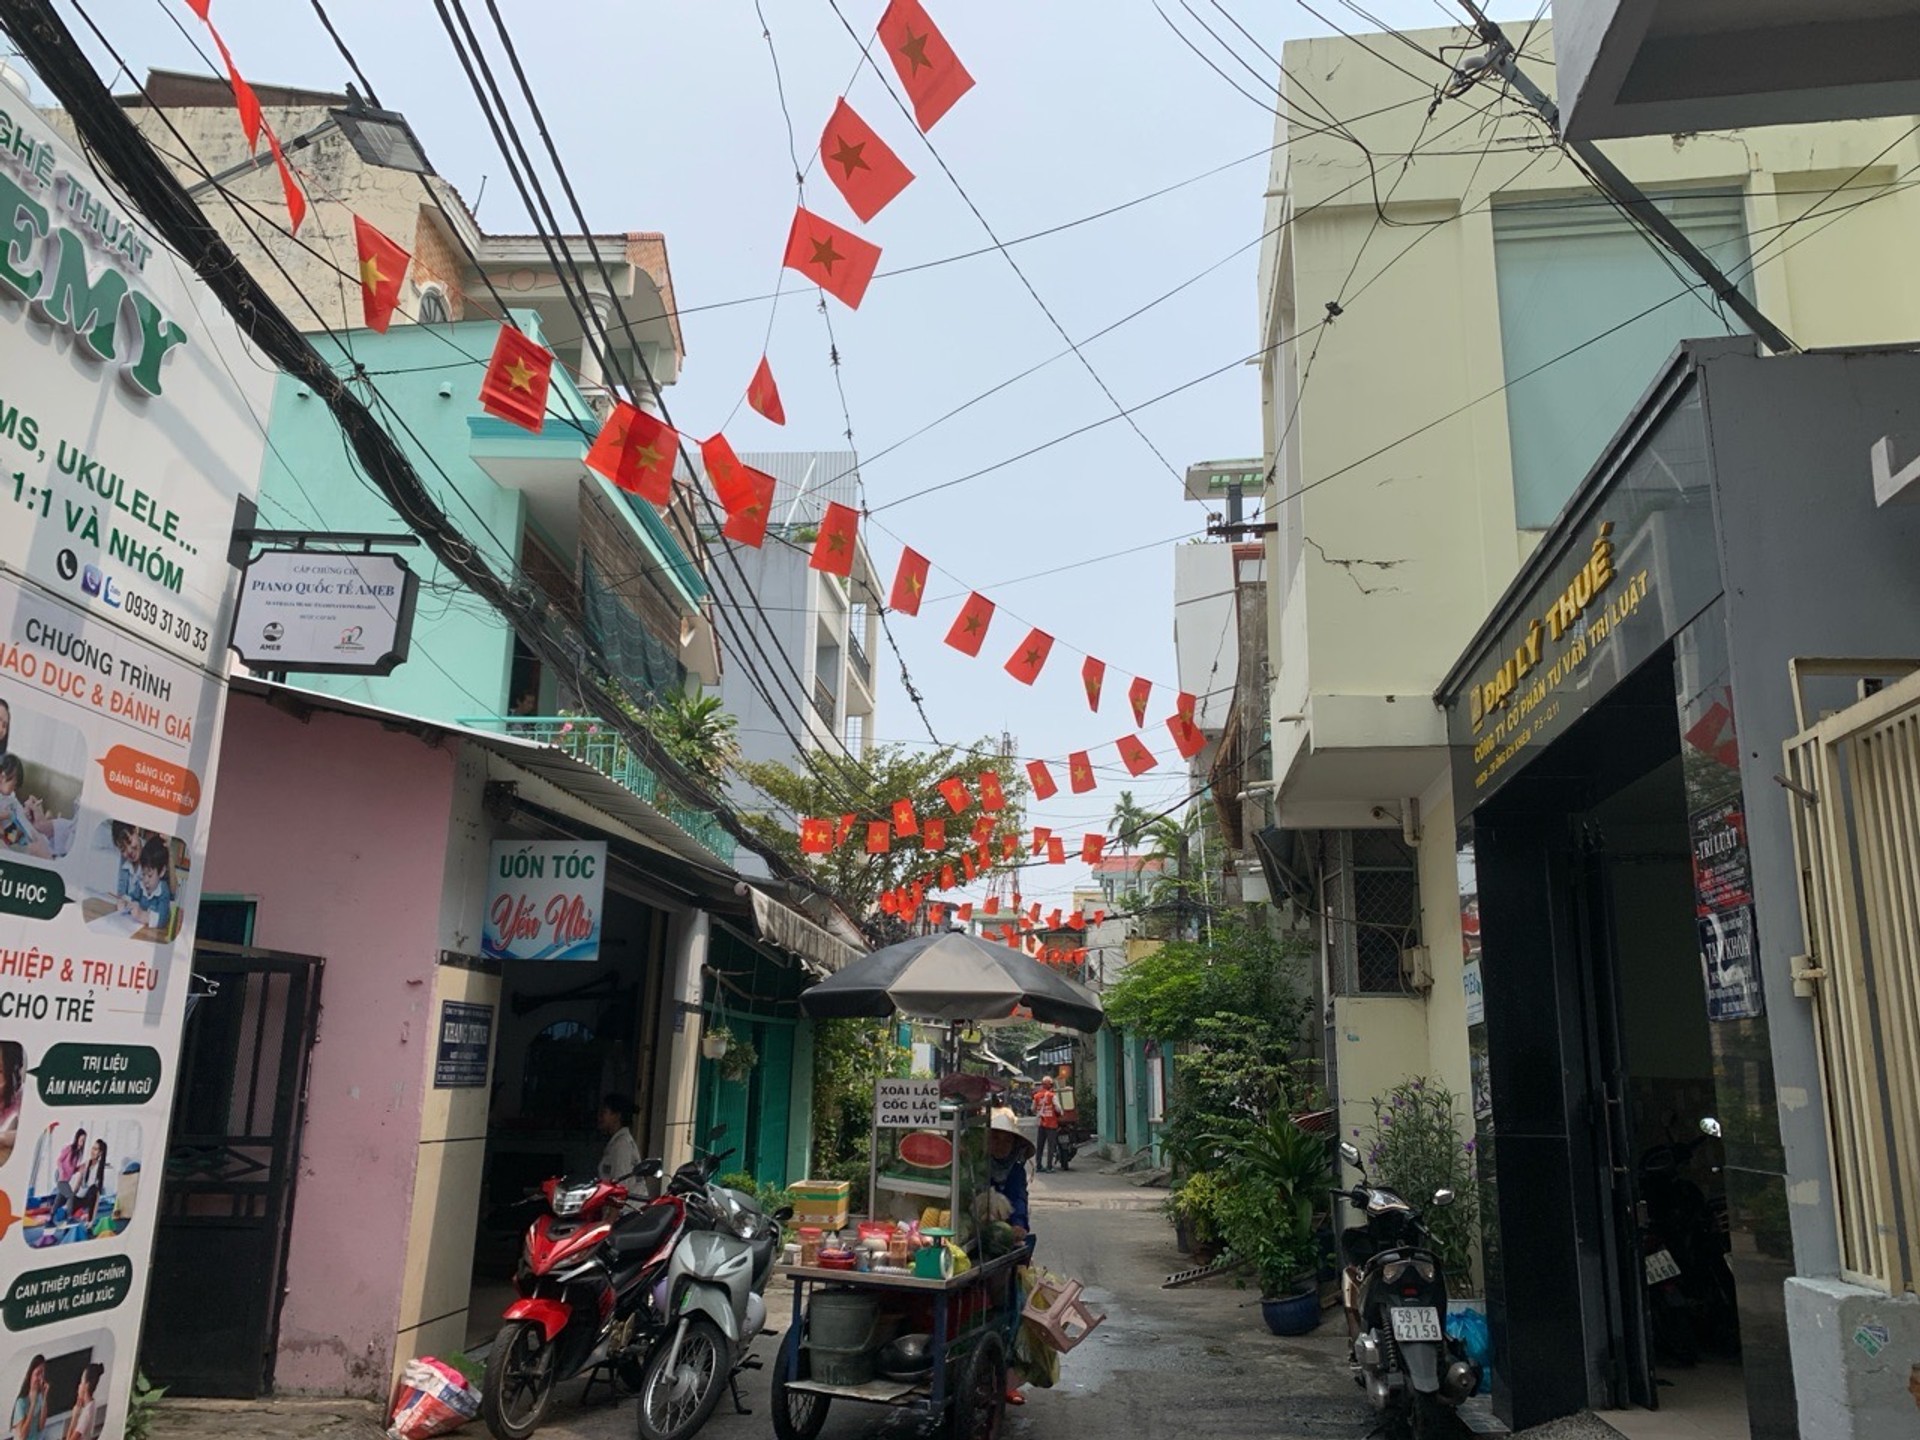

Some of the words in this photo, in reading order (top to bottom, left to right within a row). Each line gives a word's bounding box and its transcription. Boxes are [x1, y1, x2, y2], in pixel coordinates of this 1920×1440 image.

[65, 172, 152, 271] THUẬT
[57, 440, 197, 555] UKULELE...
[12, 472, 52, 517] 1:1
[65, 499, 100, 548] VÀ
[109, 527, 184, 593] NHÓM
[252, 580, 292, 593] PIANO
[295, 578, 333, 595] QUỐC
[336, 580, 353, 595] TẾ
[354, 584, 395, 597] AMEB
[1516, 618, 1544, 679] LÝ
[1545, 521, 1615, 642] THUẾ
[124, 591, 157, 624] 0939
[159, 604, 173, 634] 31
[175, 614, 190, 643] 30
[192, 626, 208, 652] 33
[26, 618, 113, 677] CHƯƠNG
[120, 659, 172, 701] TRÌNH
[1474, 732, 1495, 764] CÔNG
[1495, 719, 1506, 744] TY
[1547, 656, 1563, 689] TƯ
[1589, 604, 1610, 648] TRÍ
[1611, 569, 1648, 629] LUẬT
[41, 661, 86, 698] DỤC
[91, 684, 103, 707] &
[110, 690, 160, 730] ĐÁNH
[165, 714, 192, 742] GIÁ
[109, 770, 133, 787] ĐÁNH
[135, 779, 148, 793] GIÁ
[150, 784, 171, 799] PHÁT
[159, 771, 176, 785] LỌC
[500, 846, 544, 879] UỐN
[552, 850, 596, 879] TÓC
[15, 882, 47, 904] HỌC
[491, 893, 542, 950] Yến
[544, 894, 595, 947] Nhi
[0, 946, 54, 983] HIỆP
[60, 958, 73, 982] &
[82, 960, 113, 990] TRỊ
[117, 962, 159, 994] LIỆU
[0, 991, 48, 1020] CHO
[55, 989, 95, 1023] TRẺ
[82, 1055, 101, 1073] TRỊ
[103, 1053, 128, 1073] LIỆU
[46, 1077, 64, 1095] ÂM
[67, 1081, 101, 1097] NHẠC
[109, 1077, 125, 1094] ÂM
[127, 1078, 152, 1095] NGỮ
[881, 1084, 910, 1095] XOÀI
[882, 1115, 909, 1124] CAM
[15, 1282, 38, 1299] CAN
[41, 1275, 70, 1293] THIỆP
[97, 1263, 126, 1282] CHỈNH
[25, 1300, 55, 1318] HÀNH
[72, 1289, 93, 1307] CẢM
[95, 1286, 115, 1302] XÚC
[1398, 1309, 1432, 1324] 59-Y2
